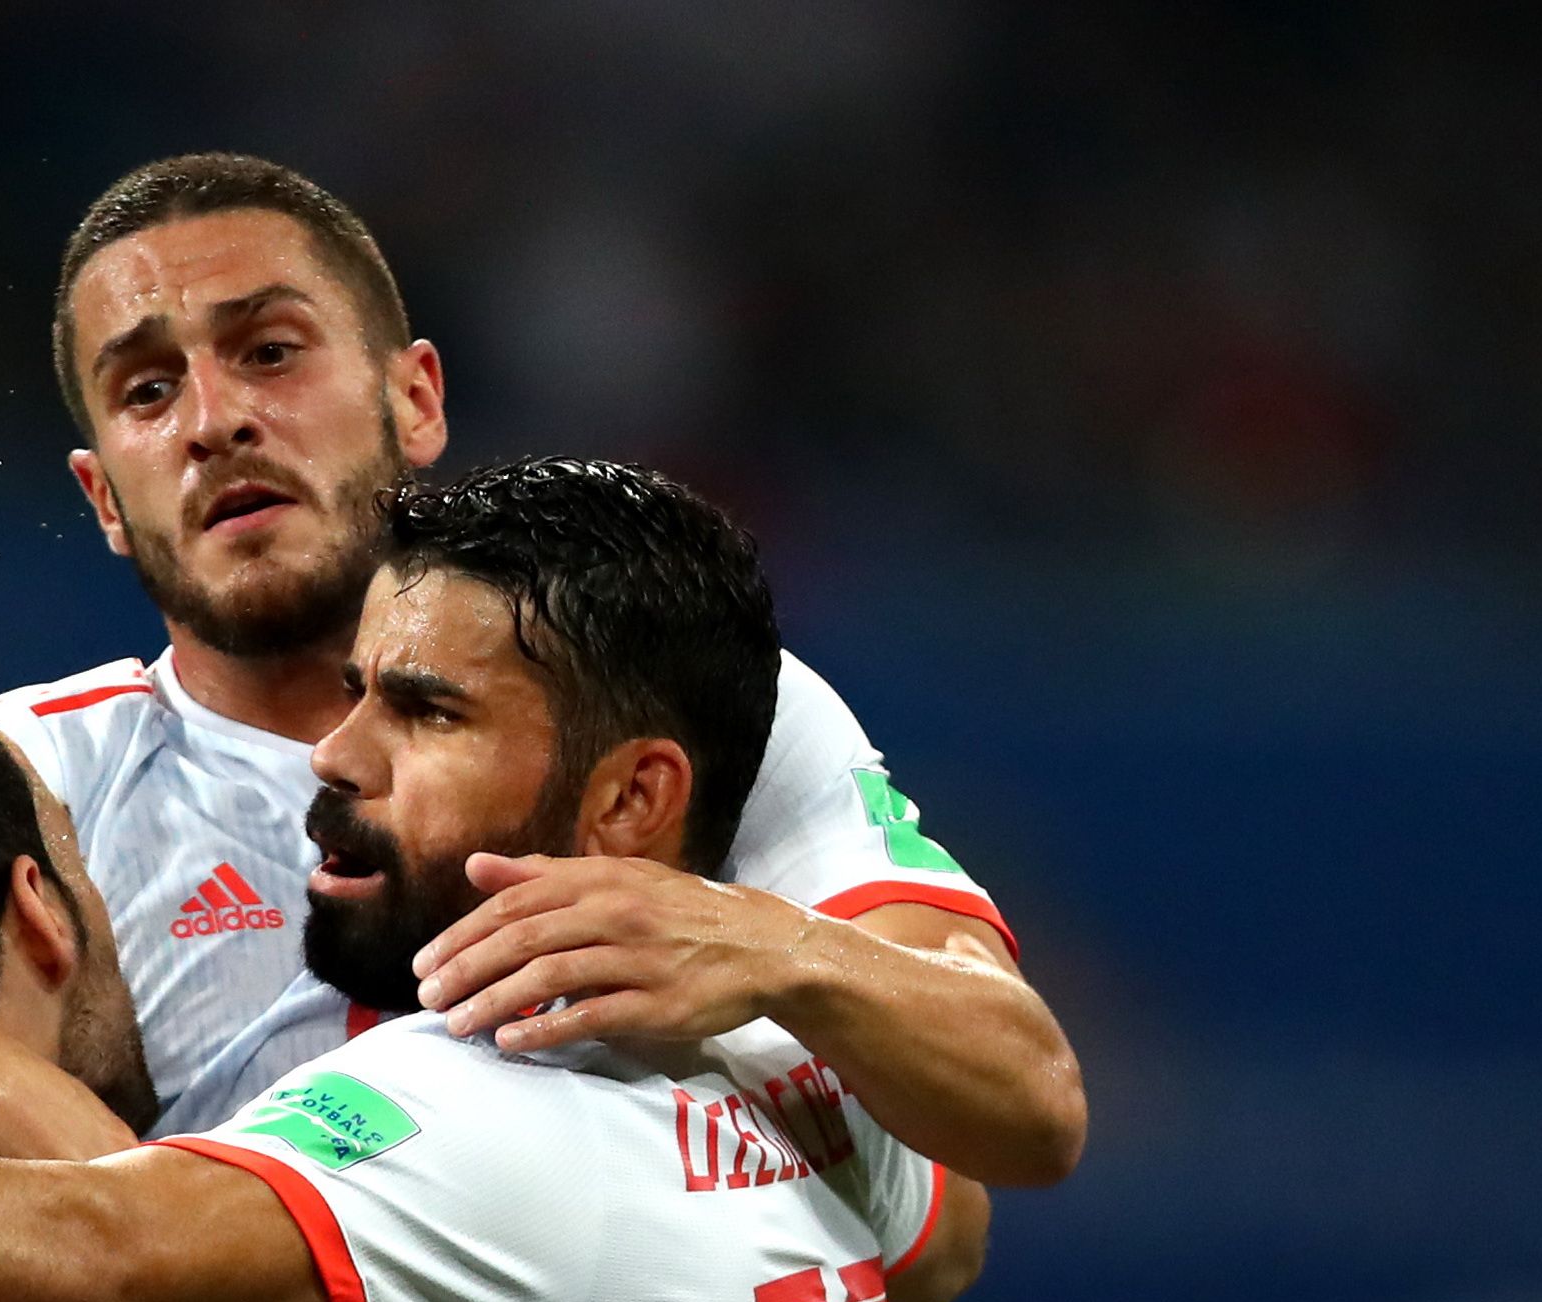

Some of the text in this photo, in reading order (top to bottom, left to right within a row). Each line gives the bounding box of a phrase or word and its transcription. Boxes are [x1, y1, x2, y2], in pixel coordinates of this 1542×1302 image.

[170, 905, 285, 939] adidas
[279, 1091, 372, 1146] FOTBALL
[304, 1088, 384, 1143] IVING
